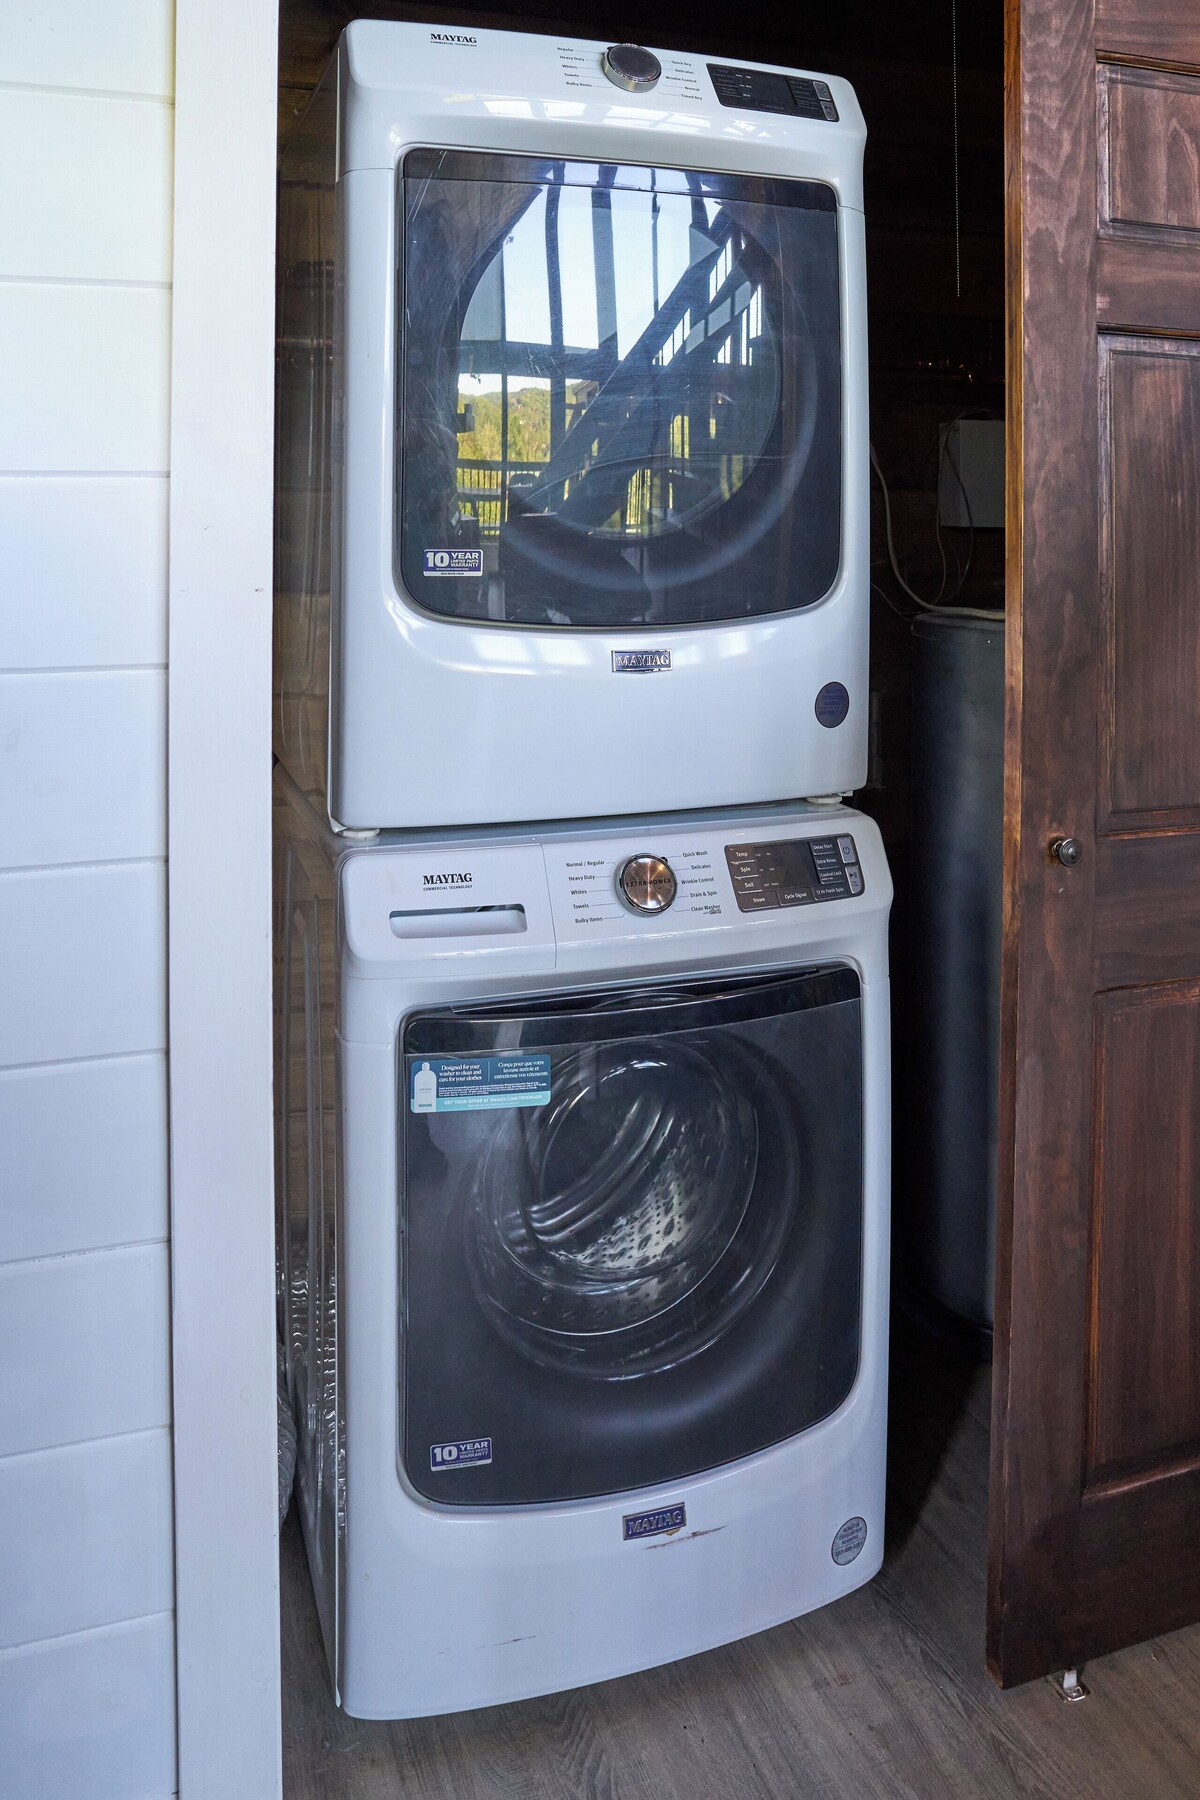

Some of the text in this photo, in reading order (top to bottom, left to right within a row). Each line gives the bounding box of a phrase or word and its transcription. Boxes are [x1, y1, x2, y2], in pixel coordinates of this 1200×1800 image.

[430, 33, 477, 43] MAYTAG
[426, 552, 450, 568] 10
[617, 654, 670, 666] MAYTAG
[422, 872, 472, 885] MAYTAG
[434, 1442, 488, 1462] 10 YEAR
[628, 1510, 682, 1534] MAYTAG
